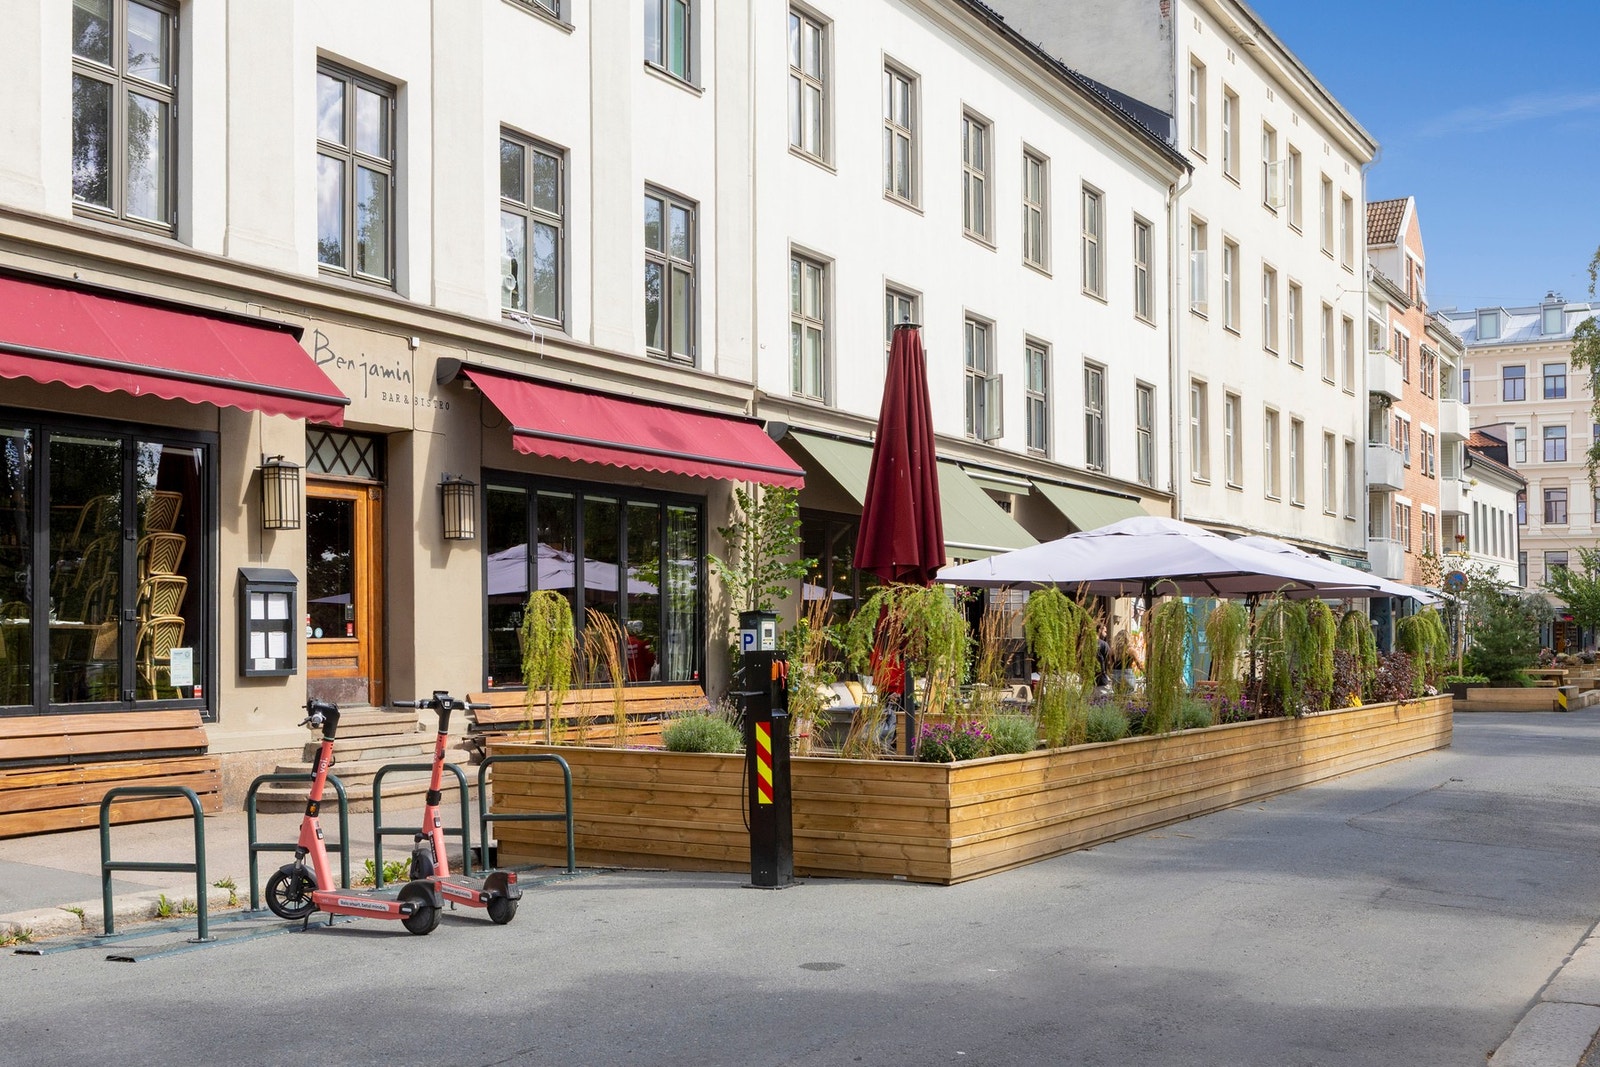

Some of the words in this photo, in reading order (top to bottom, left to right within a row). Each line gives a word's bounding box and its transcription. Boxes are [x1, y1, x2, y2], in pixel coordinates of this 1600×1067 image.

[313, 328, 411, 398] Benjamin
[382, 391, 401, 403] BAR
[404, 394, 410, 405] &
[414, 396, 450, 411] BISTRO
[744, 634, 754, 650] P
